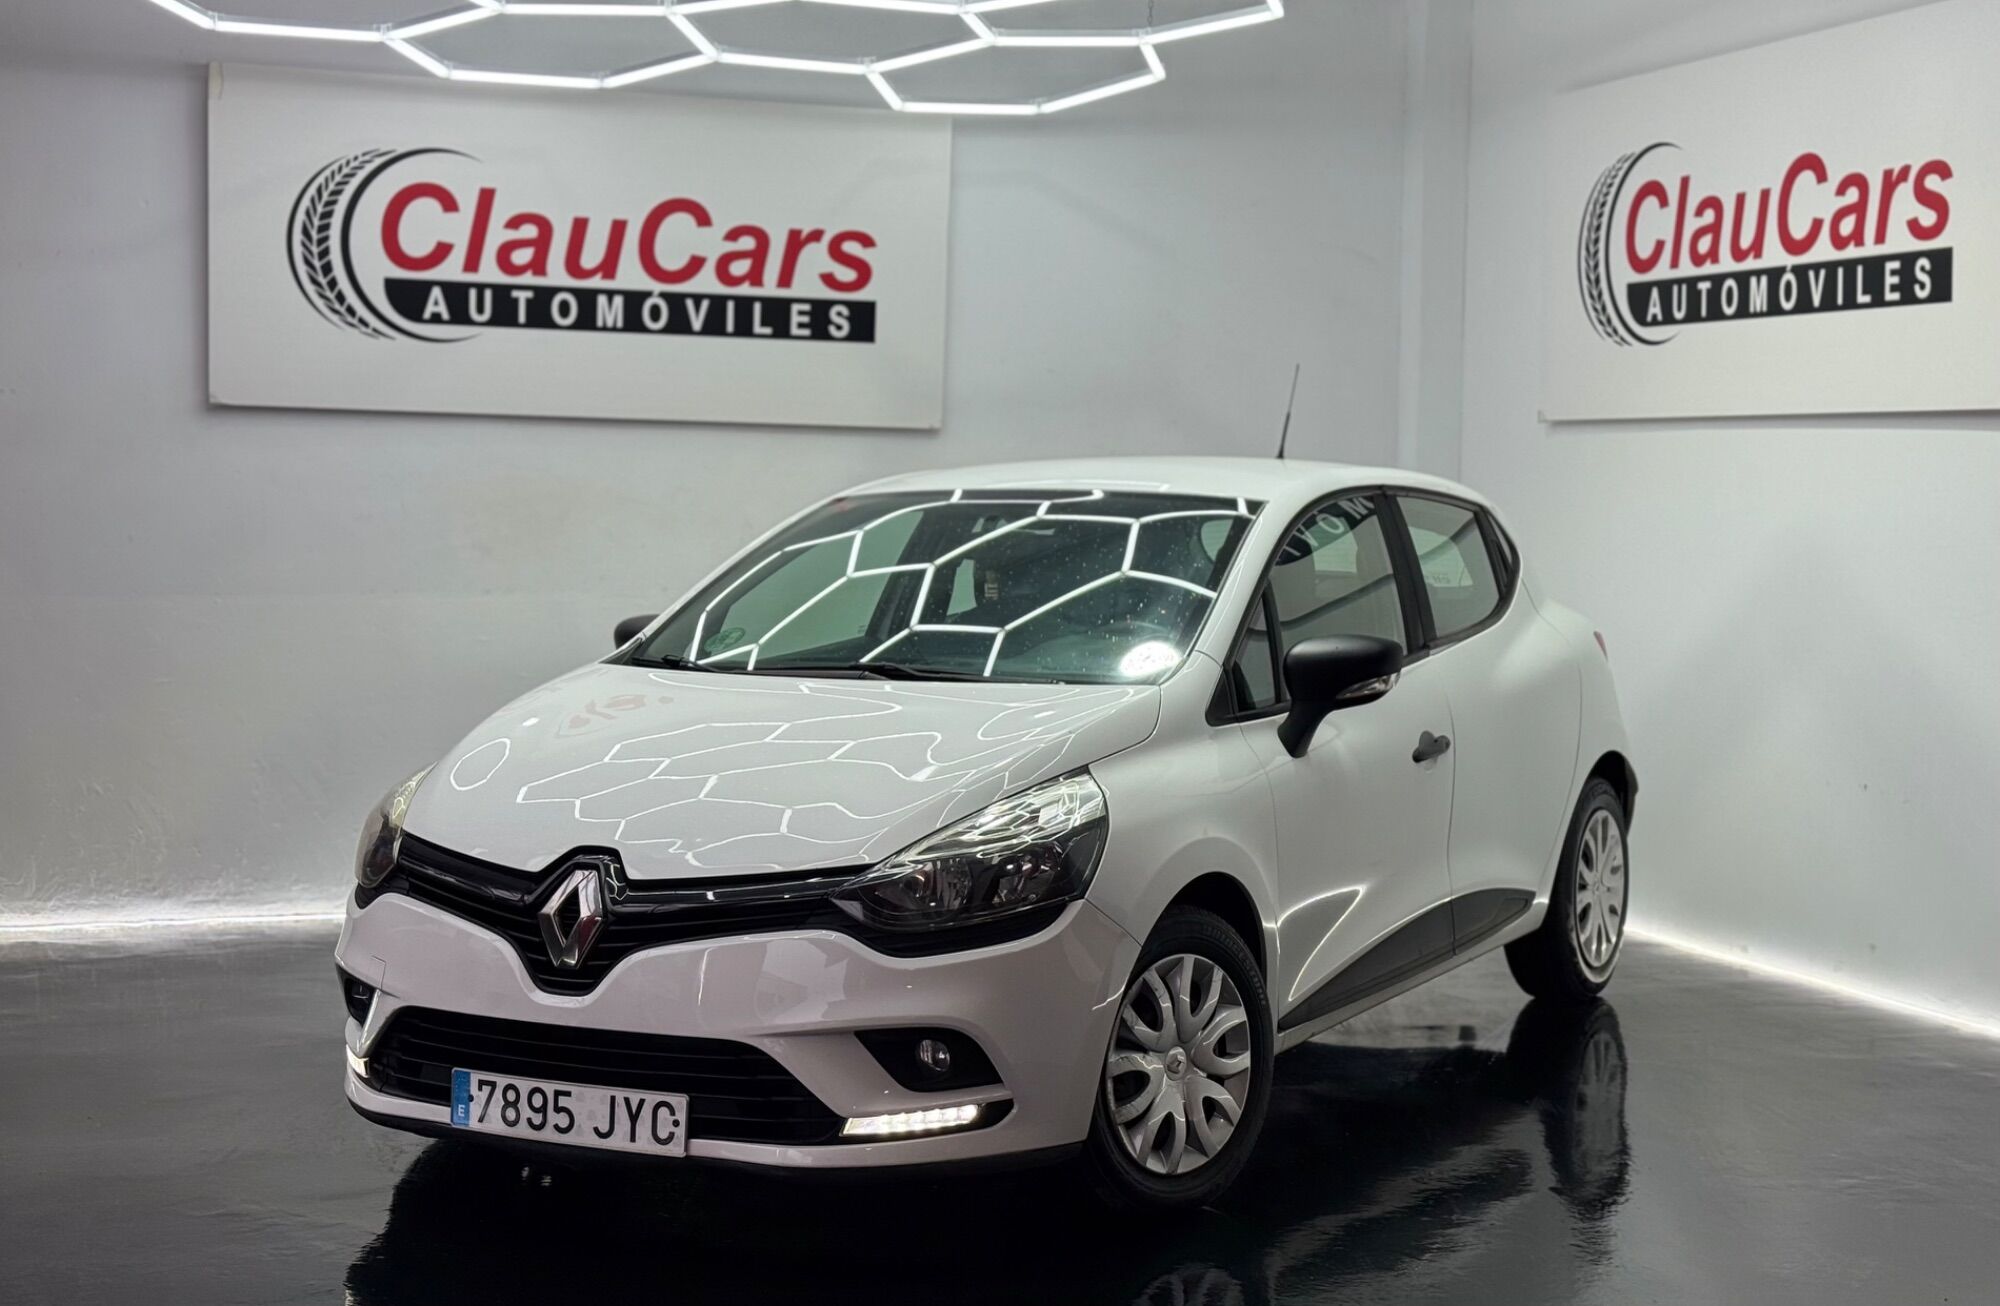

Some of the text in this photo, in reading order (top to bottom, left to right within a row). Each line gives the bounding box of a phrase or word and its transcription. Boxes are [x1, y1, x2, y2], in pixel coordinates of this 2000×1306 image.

[382, 183, 877, 293] ClauCars
[1626, 153, 1953, 274] ClauCars
[422, 285, 851, 339] AUTOMÓVILES
[1646, 257, 1932, 323] AUTOMÓVILES
[457, 1104, 466, 1118] E
[477, 1079, 676, 1146] 7895 JYC
